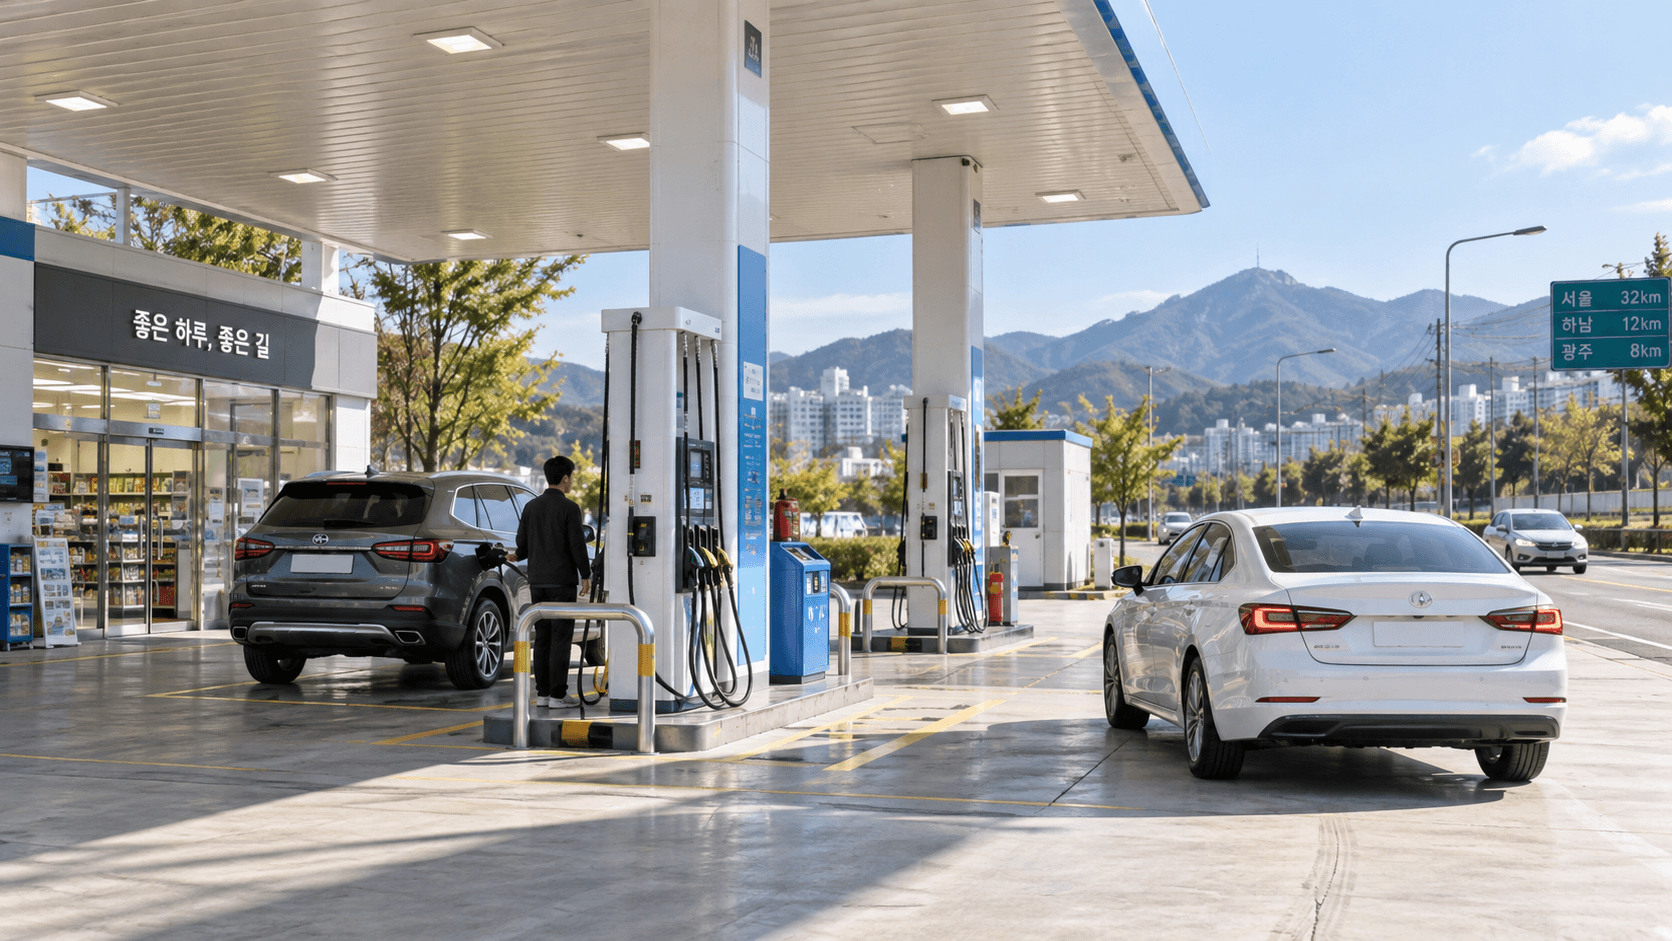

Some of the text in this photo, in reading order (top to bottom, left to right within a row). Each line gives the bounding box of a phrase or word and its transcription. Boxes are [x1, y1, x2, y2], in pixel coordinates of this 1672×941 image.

[1561, 290, 1662, 308] 서울 32km
[1561, 315, 1662, 334] 하남 12km
[133, 309, 270, 360] 좋은 하루, 좋은 길
[1561, 343, 1662, 361] 광주 8km
